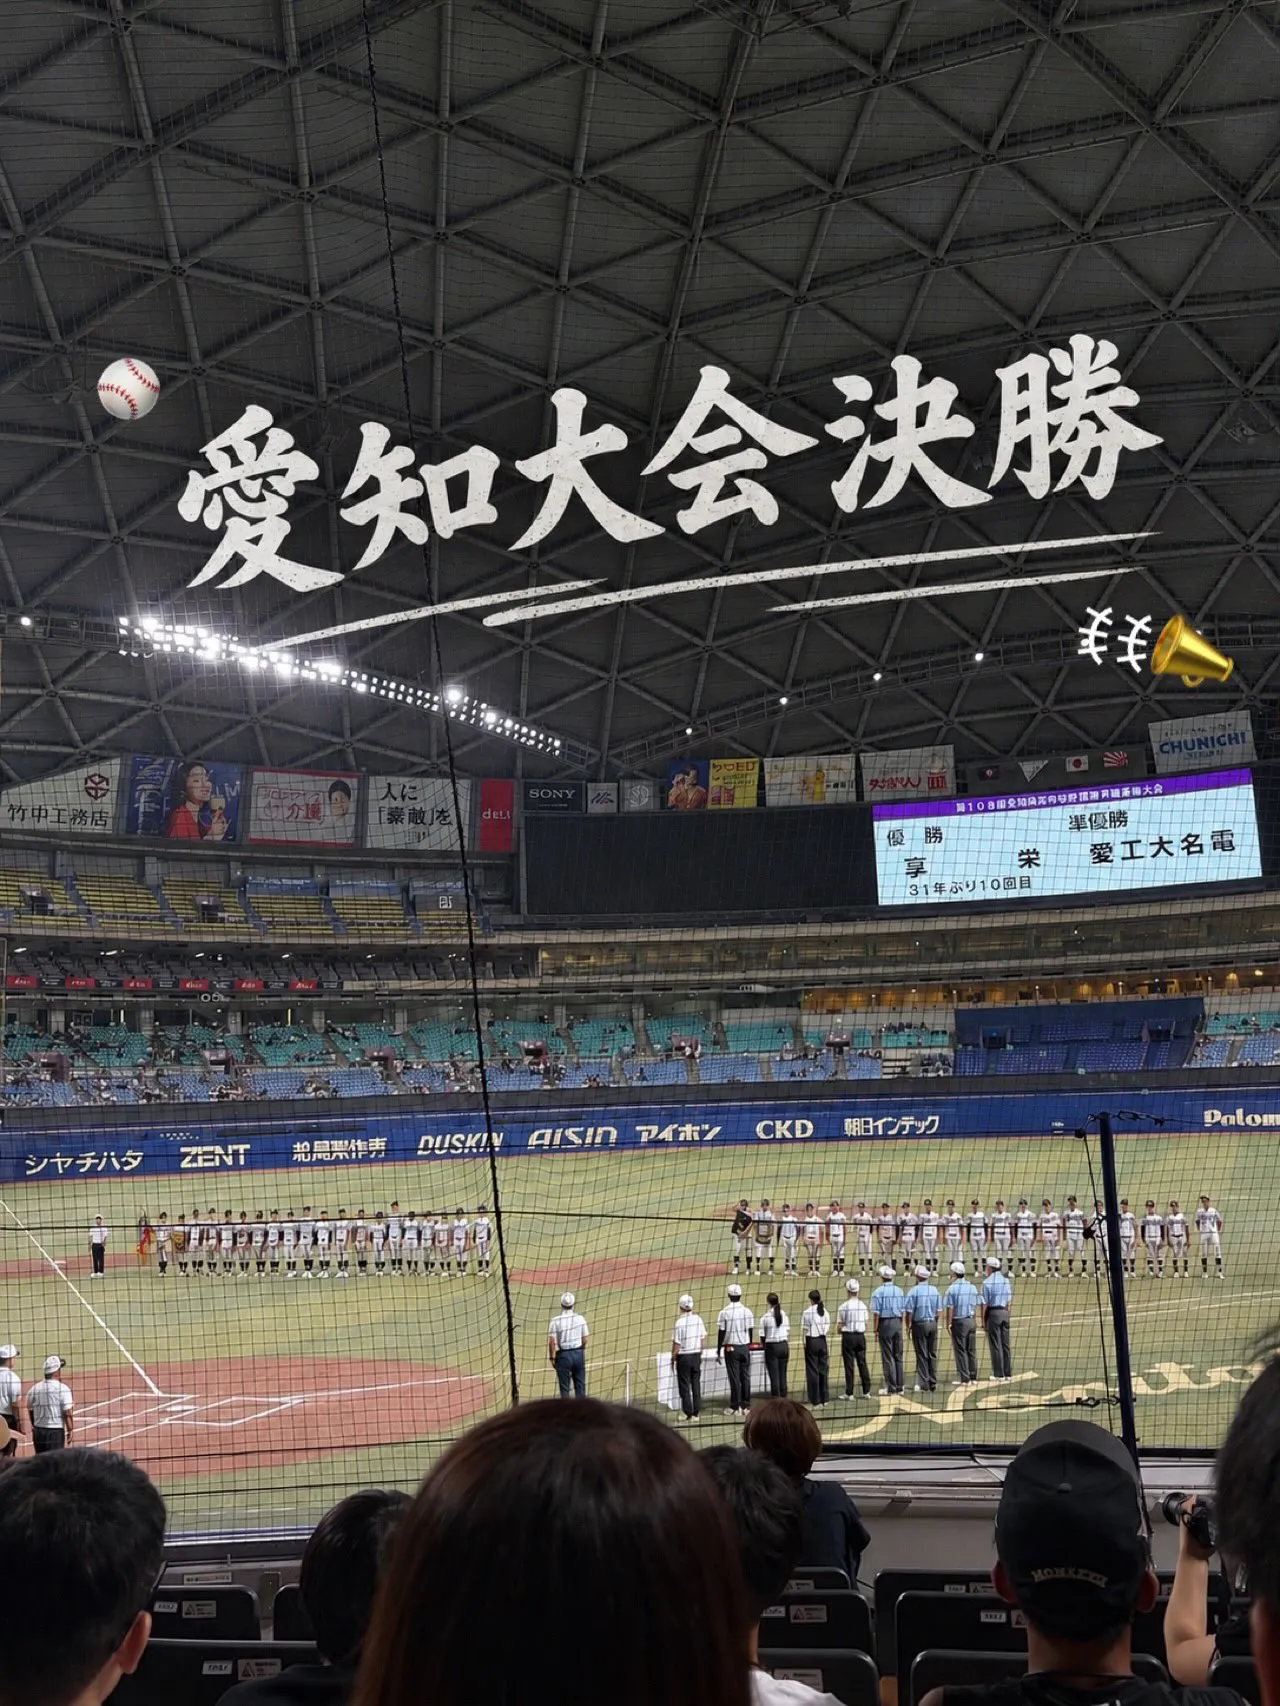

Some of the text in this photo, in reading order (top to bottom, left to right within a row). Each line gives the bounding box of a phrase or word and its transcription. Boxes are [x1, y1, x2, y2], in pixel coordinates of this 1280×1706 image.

[1159, 731, 1247, 754] CHUNICHI
[380, 783, 418, 801] 人に
[529, 788, 576, 799] SONY
[7, 803, 109, 828] 竹中工務店
[1068, 810, 1128, 832] 準優勝
[1090, 829, 1236, 865] 愛工大名電
[909, 875, 1032, 897] 31年ぶり10回目
[756, 1119, 814, 1139] CKD
[844, 1115, 939, 1137] 朝日インテック
[417, 1132, 504, 1155] DUSKIN
[527, 1126, 617, 1149] AISIN
[180, 1144, 250, 1168] ZENT
